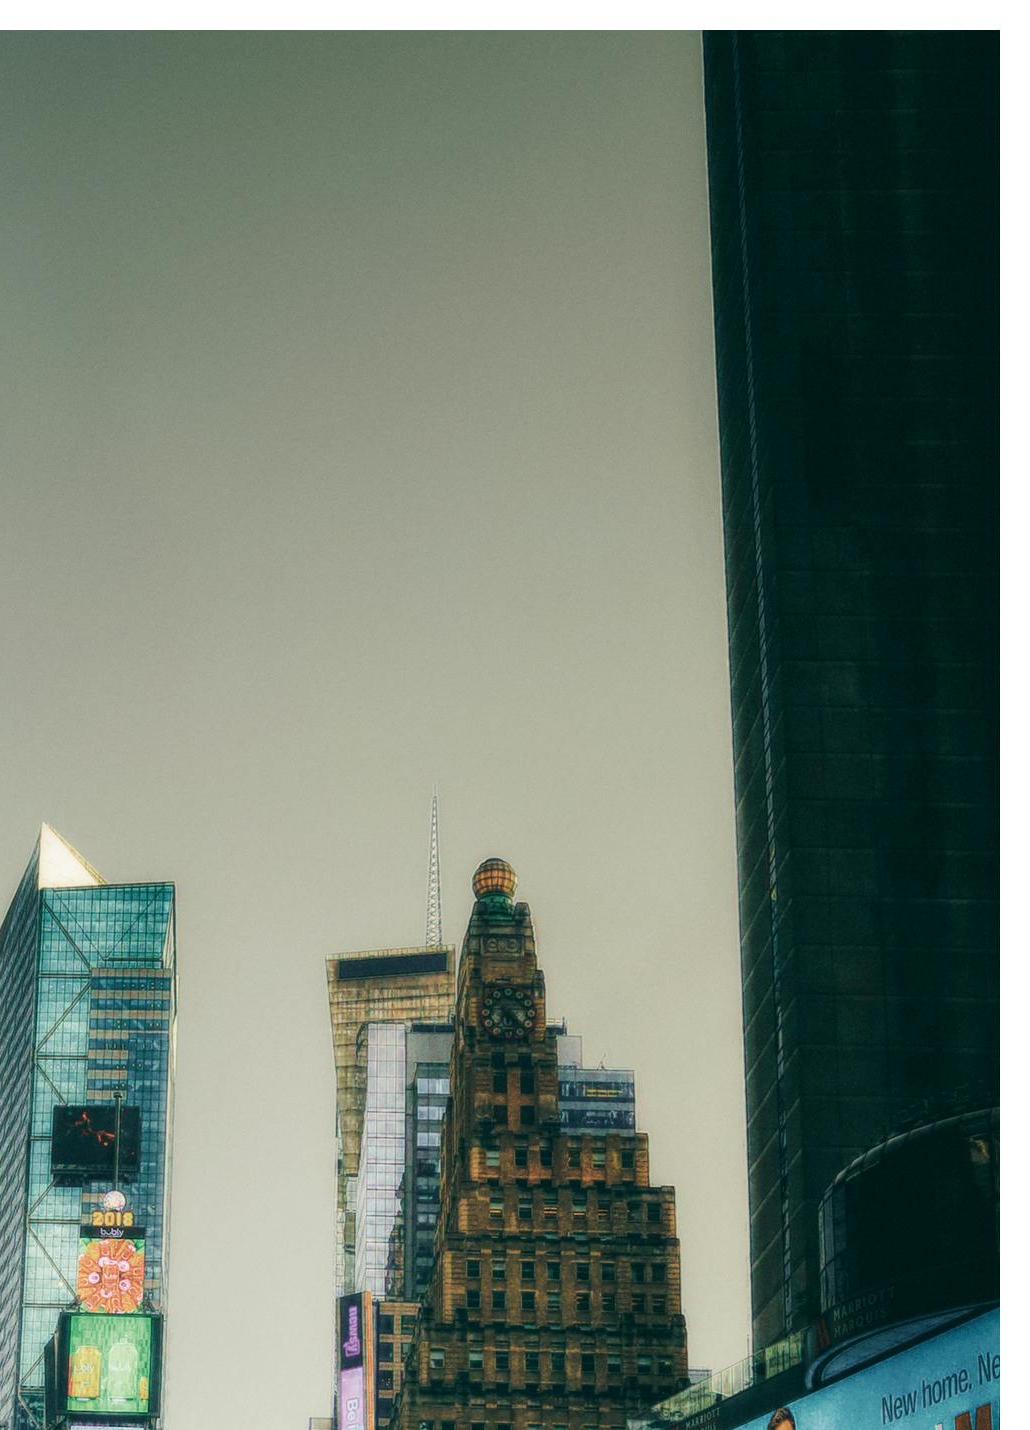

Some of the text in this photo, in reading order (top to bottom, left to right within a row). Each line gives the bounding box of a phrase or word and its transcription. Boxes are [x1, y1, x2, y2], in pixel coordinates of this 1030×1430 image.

[92, 1211, 134, 1226] 2018
[833, 1286, 896, 1321] MARRIOTT
[343, 1305, 361, 1357] newsy
[834, 1307, 889, 1338] MARQUIS
[685, 1408, 720, 1428] MARRIOTT
[881, 1390, 918, 1424] New
